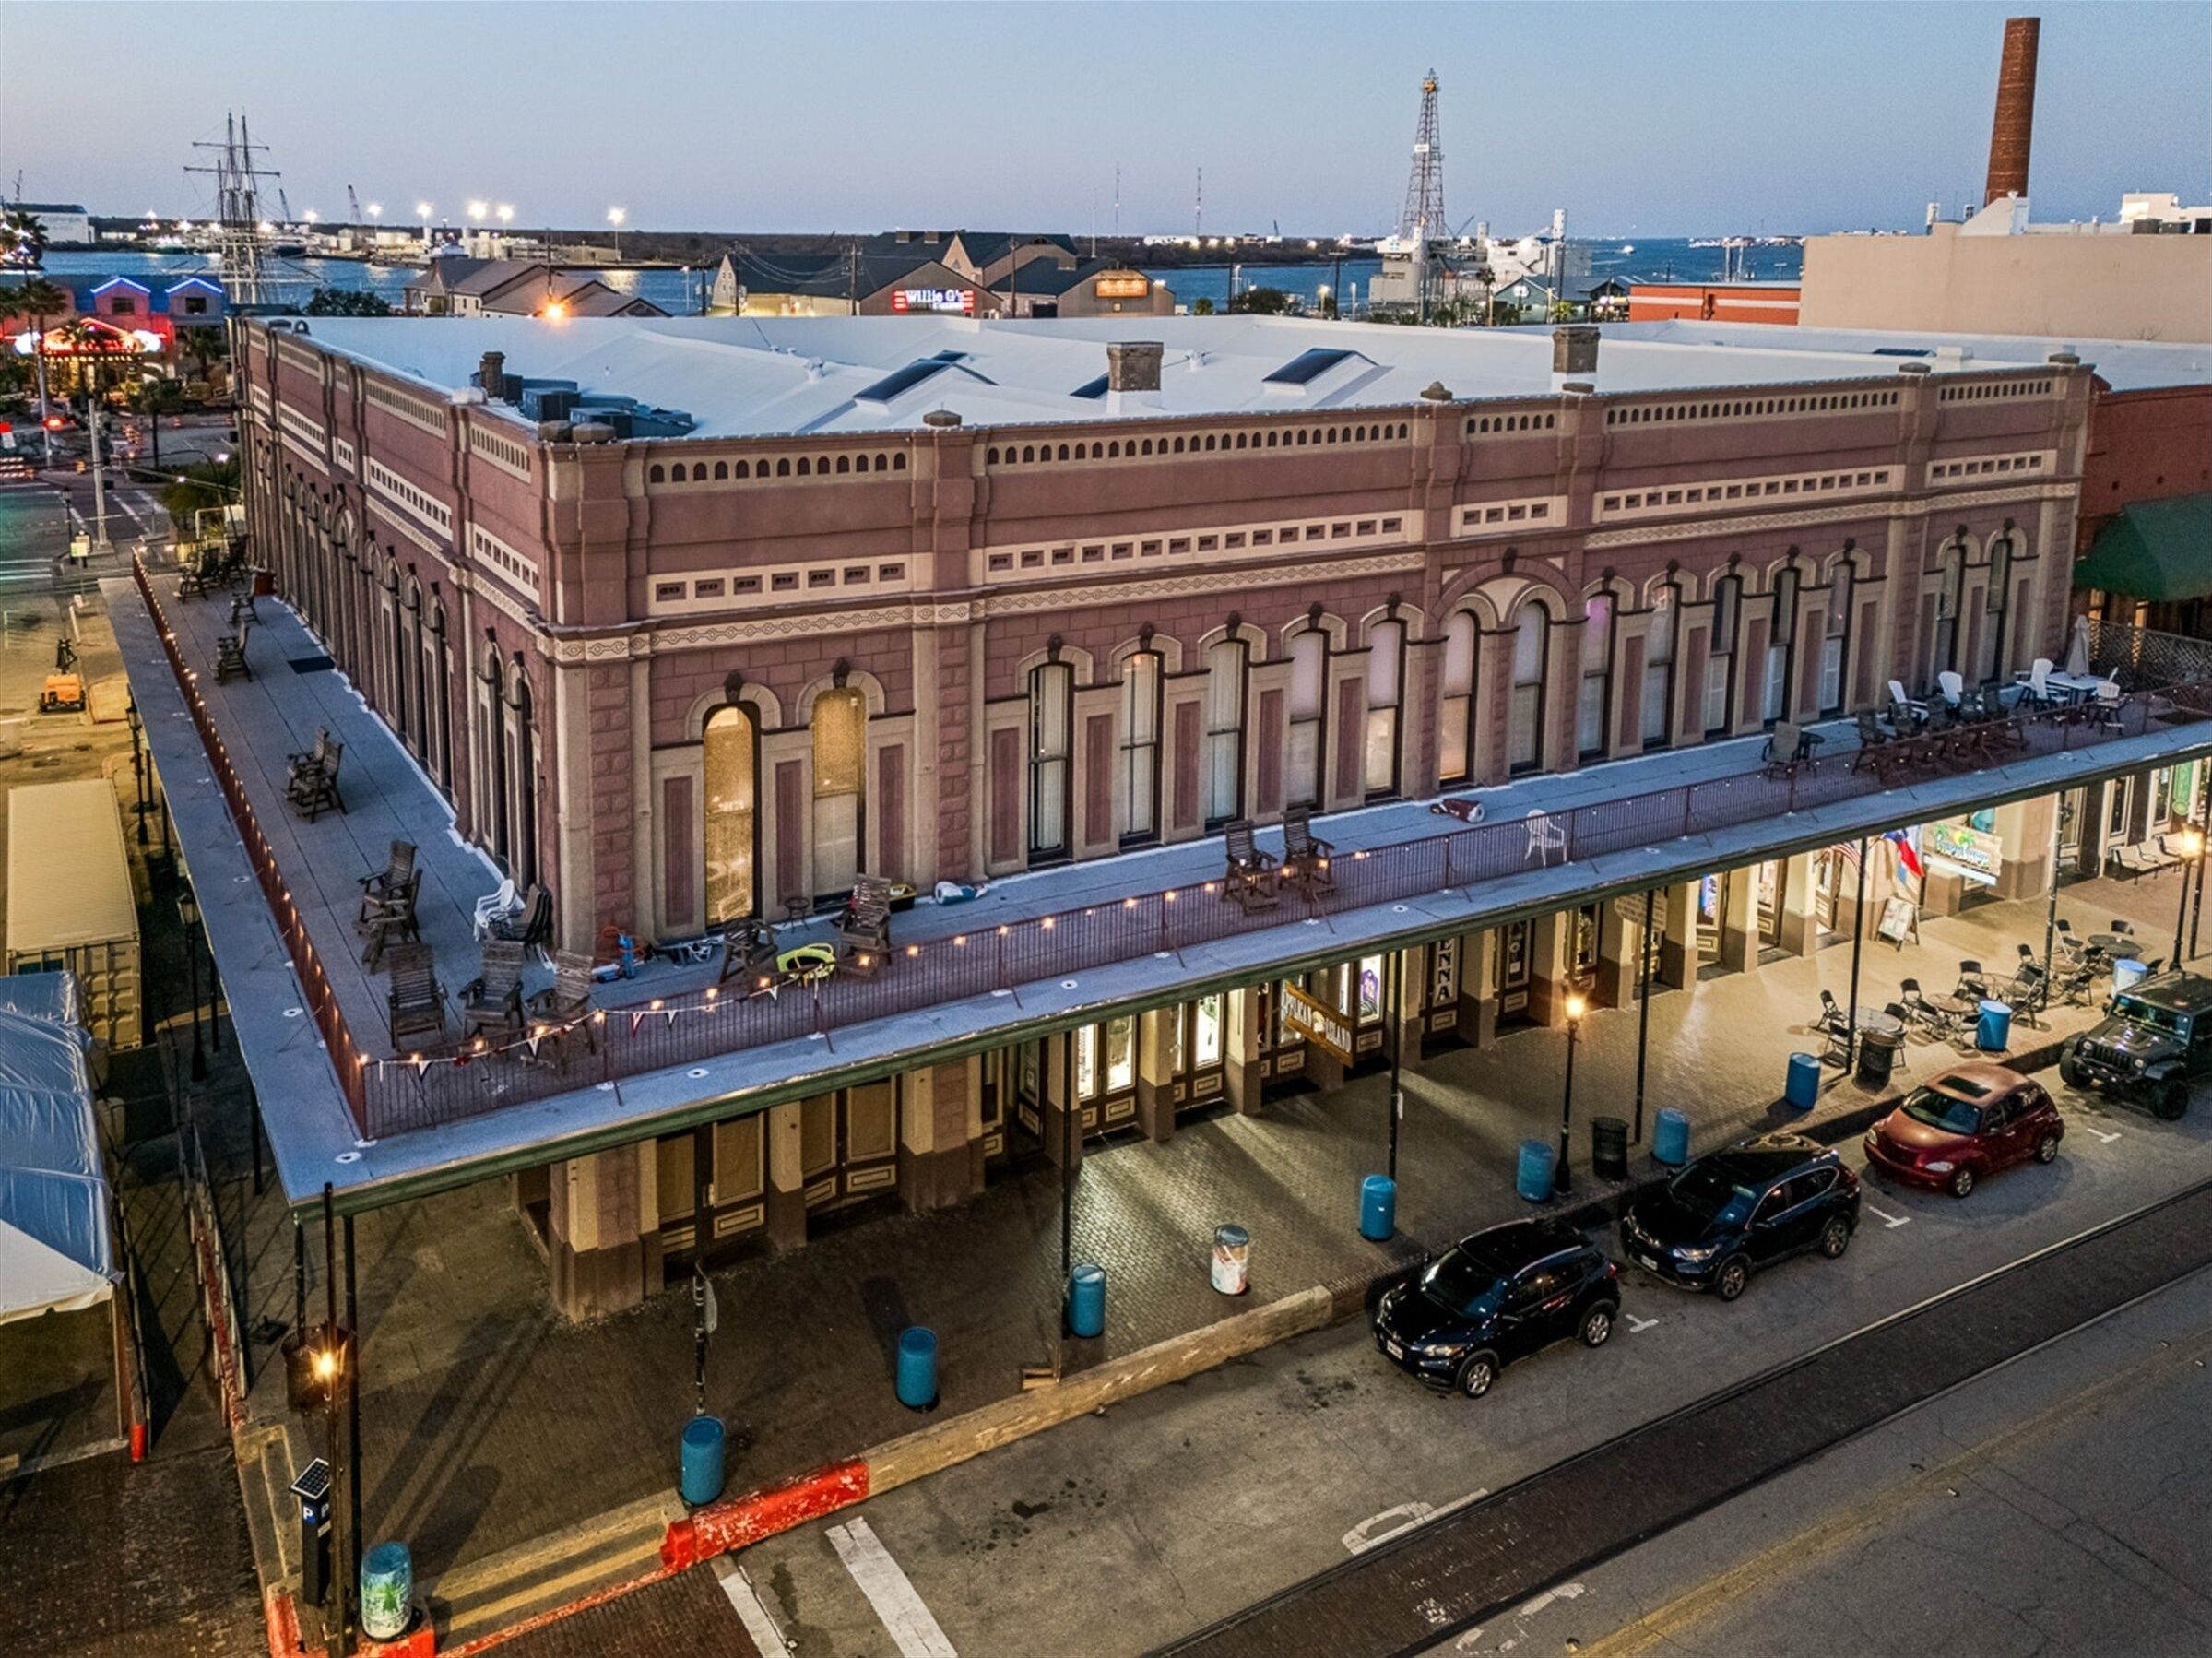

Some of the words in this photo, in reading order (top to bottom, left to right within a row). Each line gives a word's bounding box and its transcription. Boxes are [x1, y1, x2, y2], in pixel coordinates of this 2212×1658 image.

[1325, 1017, 1352, 1053] ISLAND
[302, 1506, 314, 1520] P
[320, 1503, 330, 1518] P
